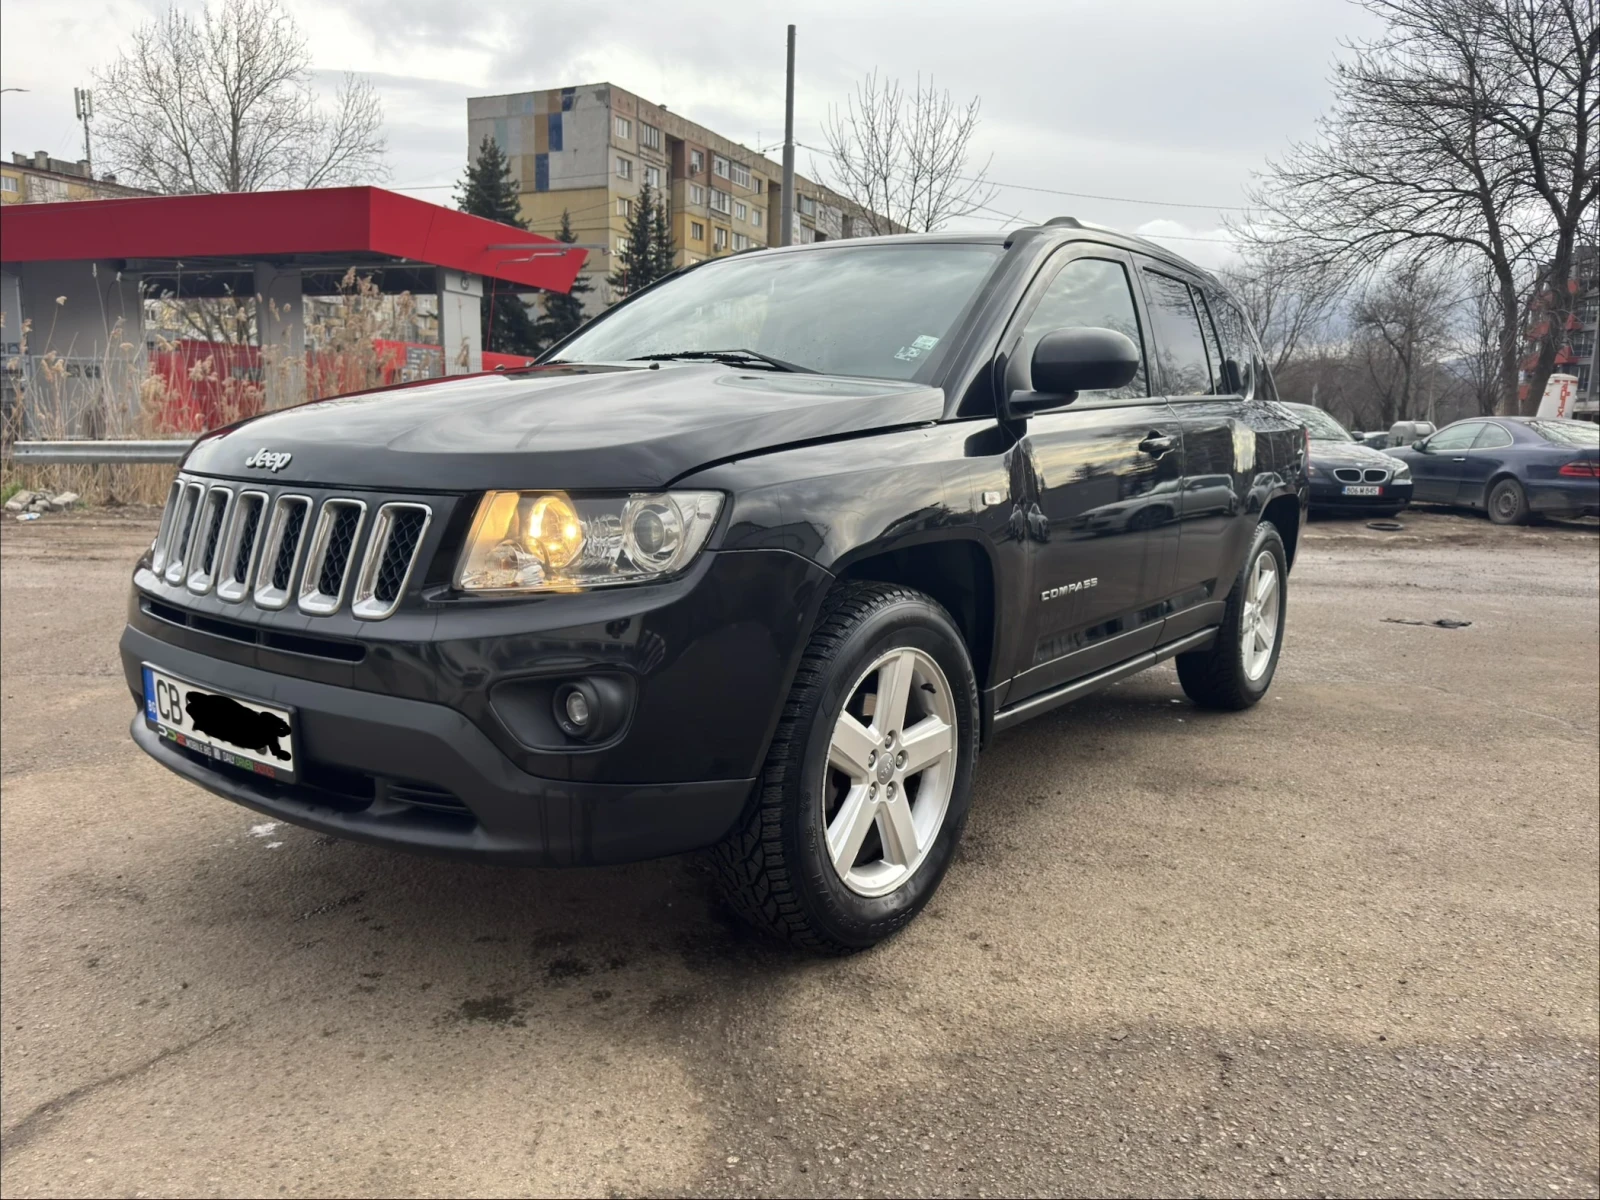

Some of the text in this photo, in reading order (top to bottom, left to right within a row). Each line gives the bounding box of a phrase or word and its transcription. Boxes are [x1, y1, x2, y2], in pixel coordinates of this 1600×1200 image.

[245, 447, 292, 473] Jeep
[1041, 577, 1098, 602] COMPASS
[156, 679, 183, 725] CB
